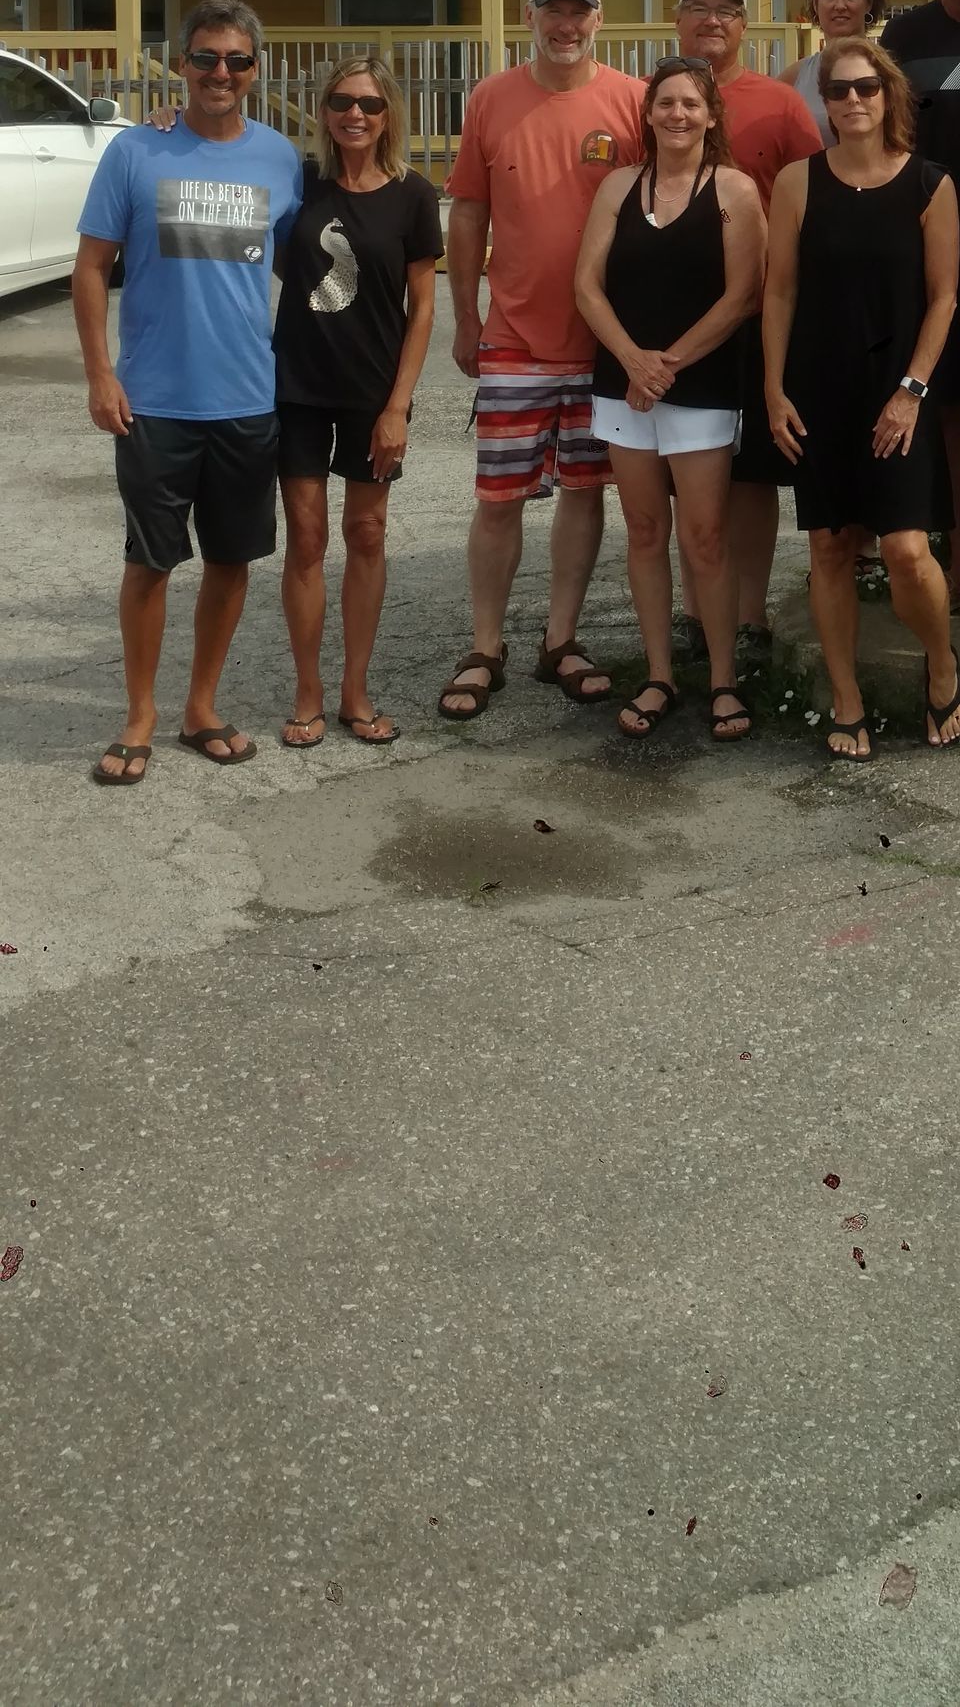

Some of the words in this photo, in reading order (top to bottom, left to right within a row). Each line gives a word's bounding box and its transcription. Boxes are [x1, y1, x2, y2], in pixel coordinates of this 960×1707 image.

[180, 181, 200, 200] LIFE
[204, 182, 214, 201] IS
[218, 183, 254, 205] BETTER
[178, 201, 195, 222] ON
[201, 202, 222, 224] THE
[226, 204, 255, 228] LAKE
